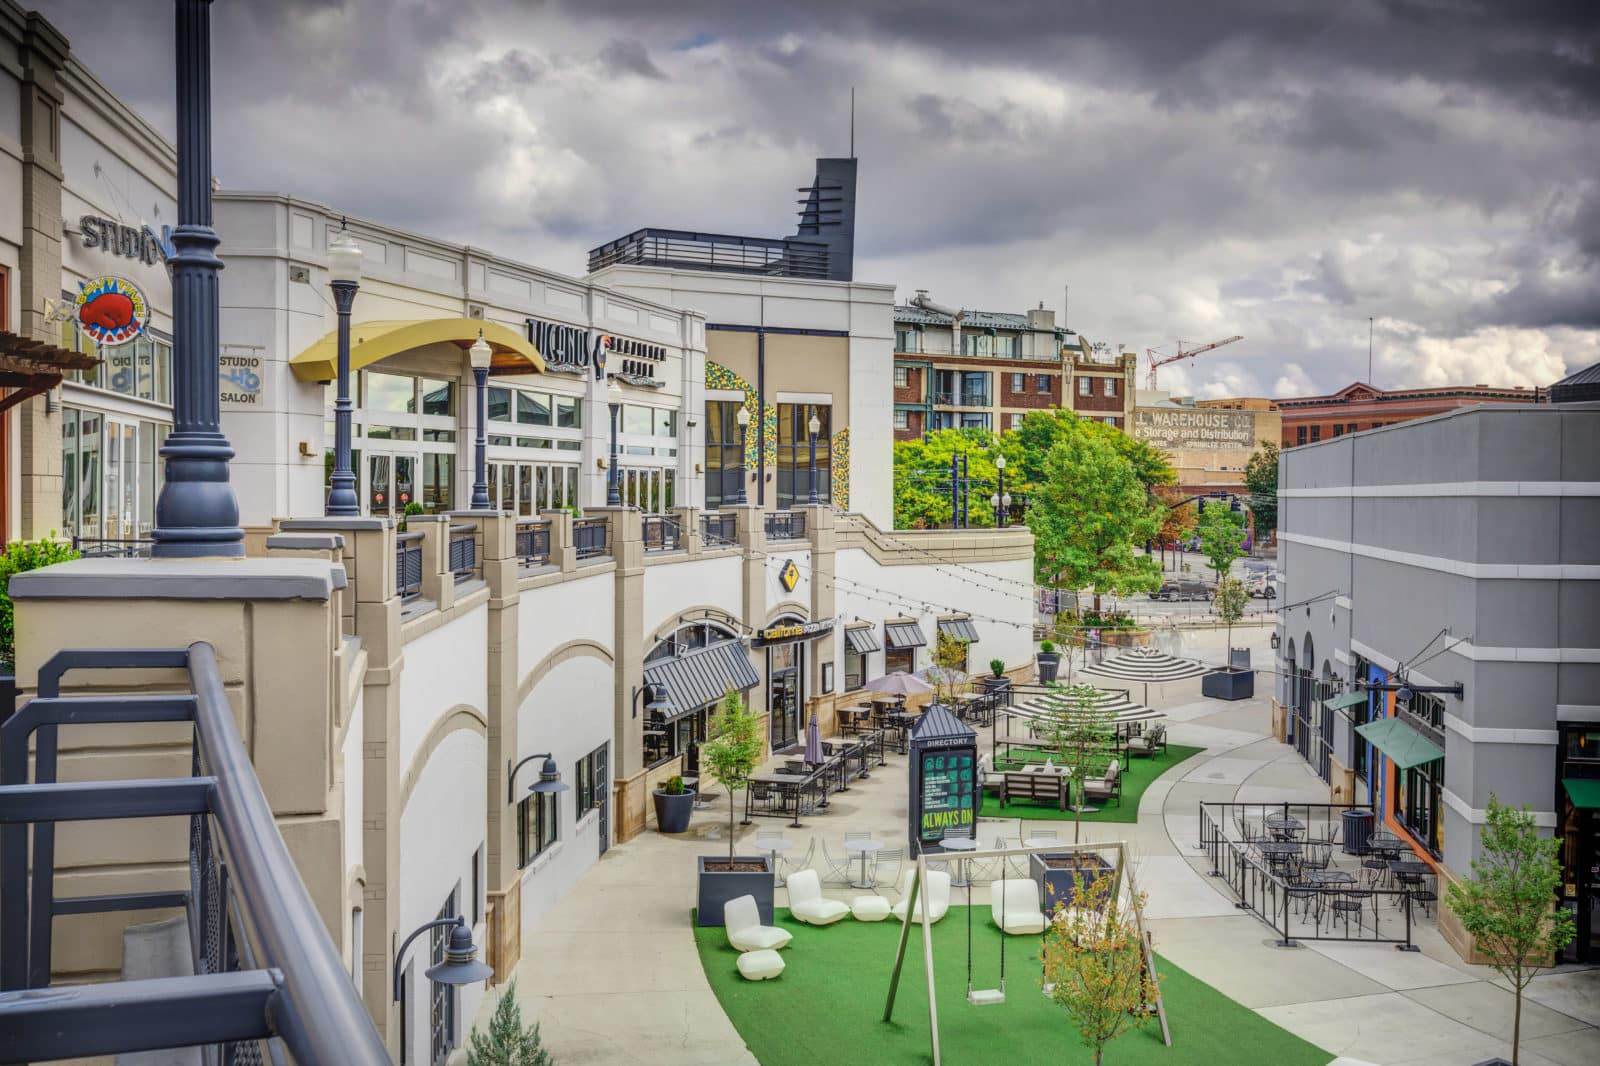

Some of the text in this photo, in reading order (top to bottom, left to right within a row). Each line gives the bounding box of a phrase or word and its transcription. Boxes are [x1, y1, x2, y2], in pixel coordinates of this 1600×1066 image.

[80, 215, 158, 267] STUDIO
[526, 318, 592, 367] TUCANOS
[219, 356, 259, 367] STUDIO
[220, 392, 256, 403] SALON
[1151, 412, 1229, 428] WAREHOUSE
[1143, 426, 1179, 441] Storage
[1181, 428, 1199, 439] and
[1200, 429, 1249, 440] Distribution
[927, 738, 968, 747] DIRECTORY
[923, 808, 973, 828] ALWAYS ON
